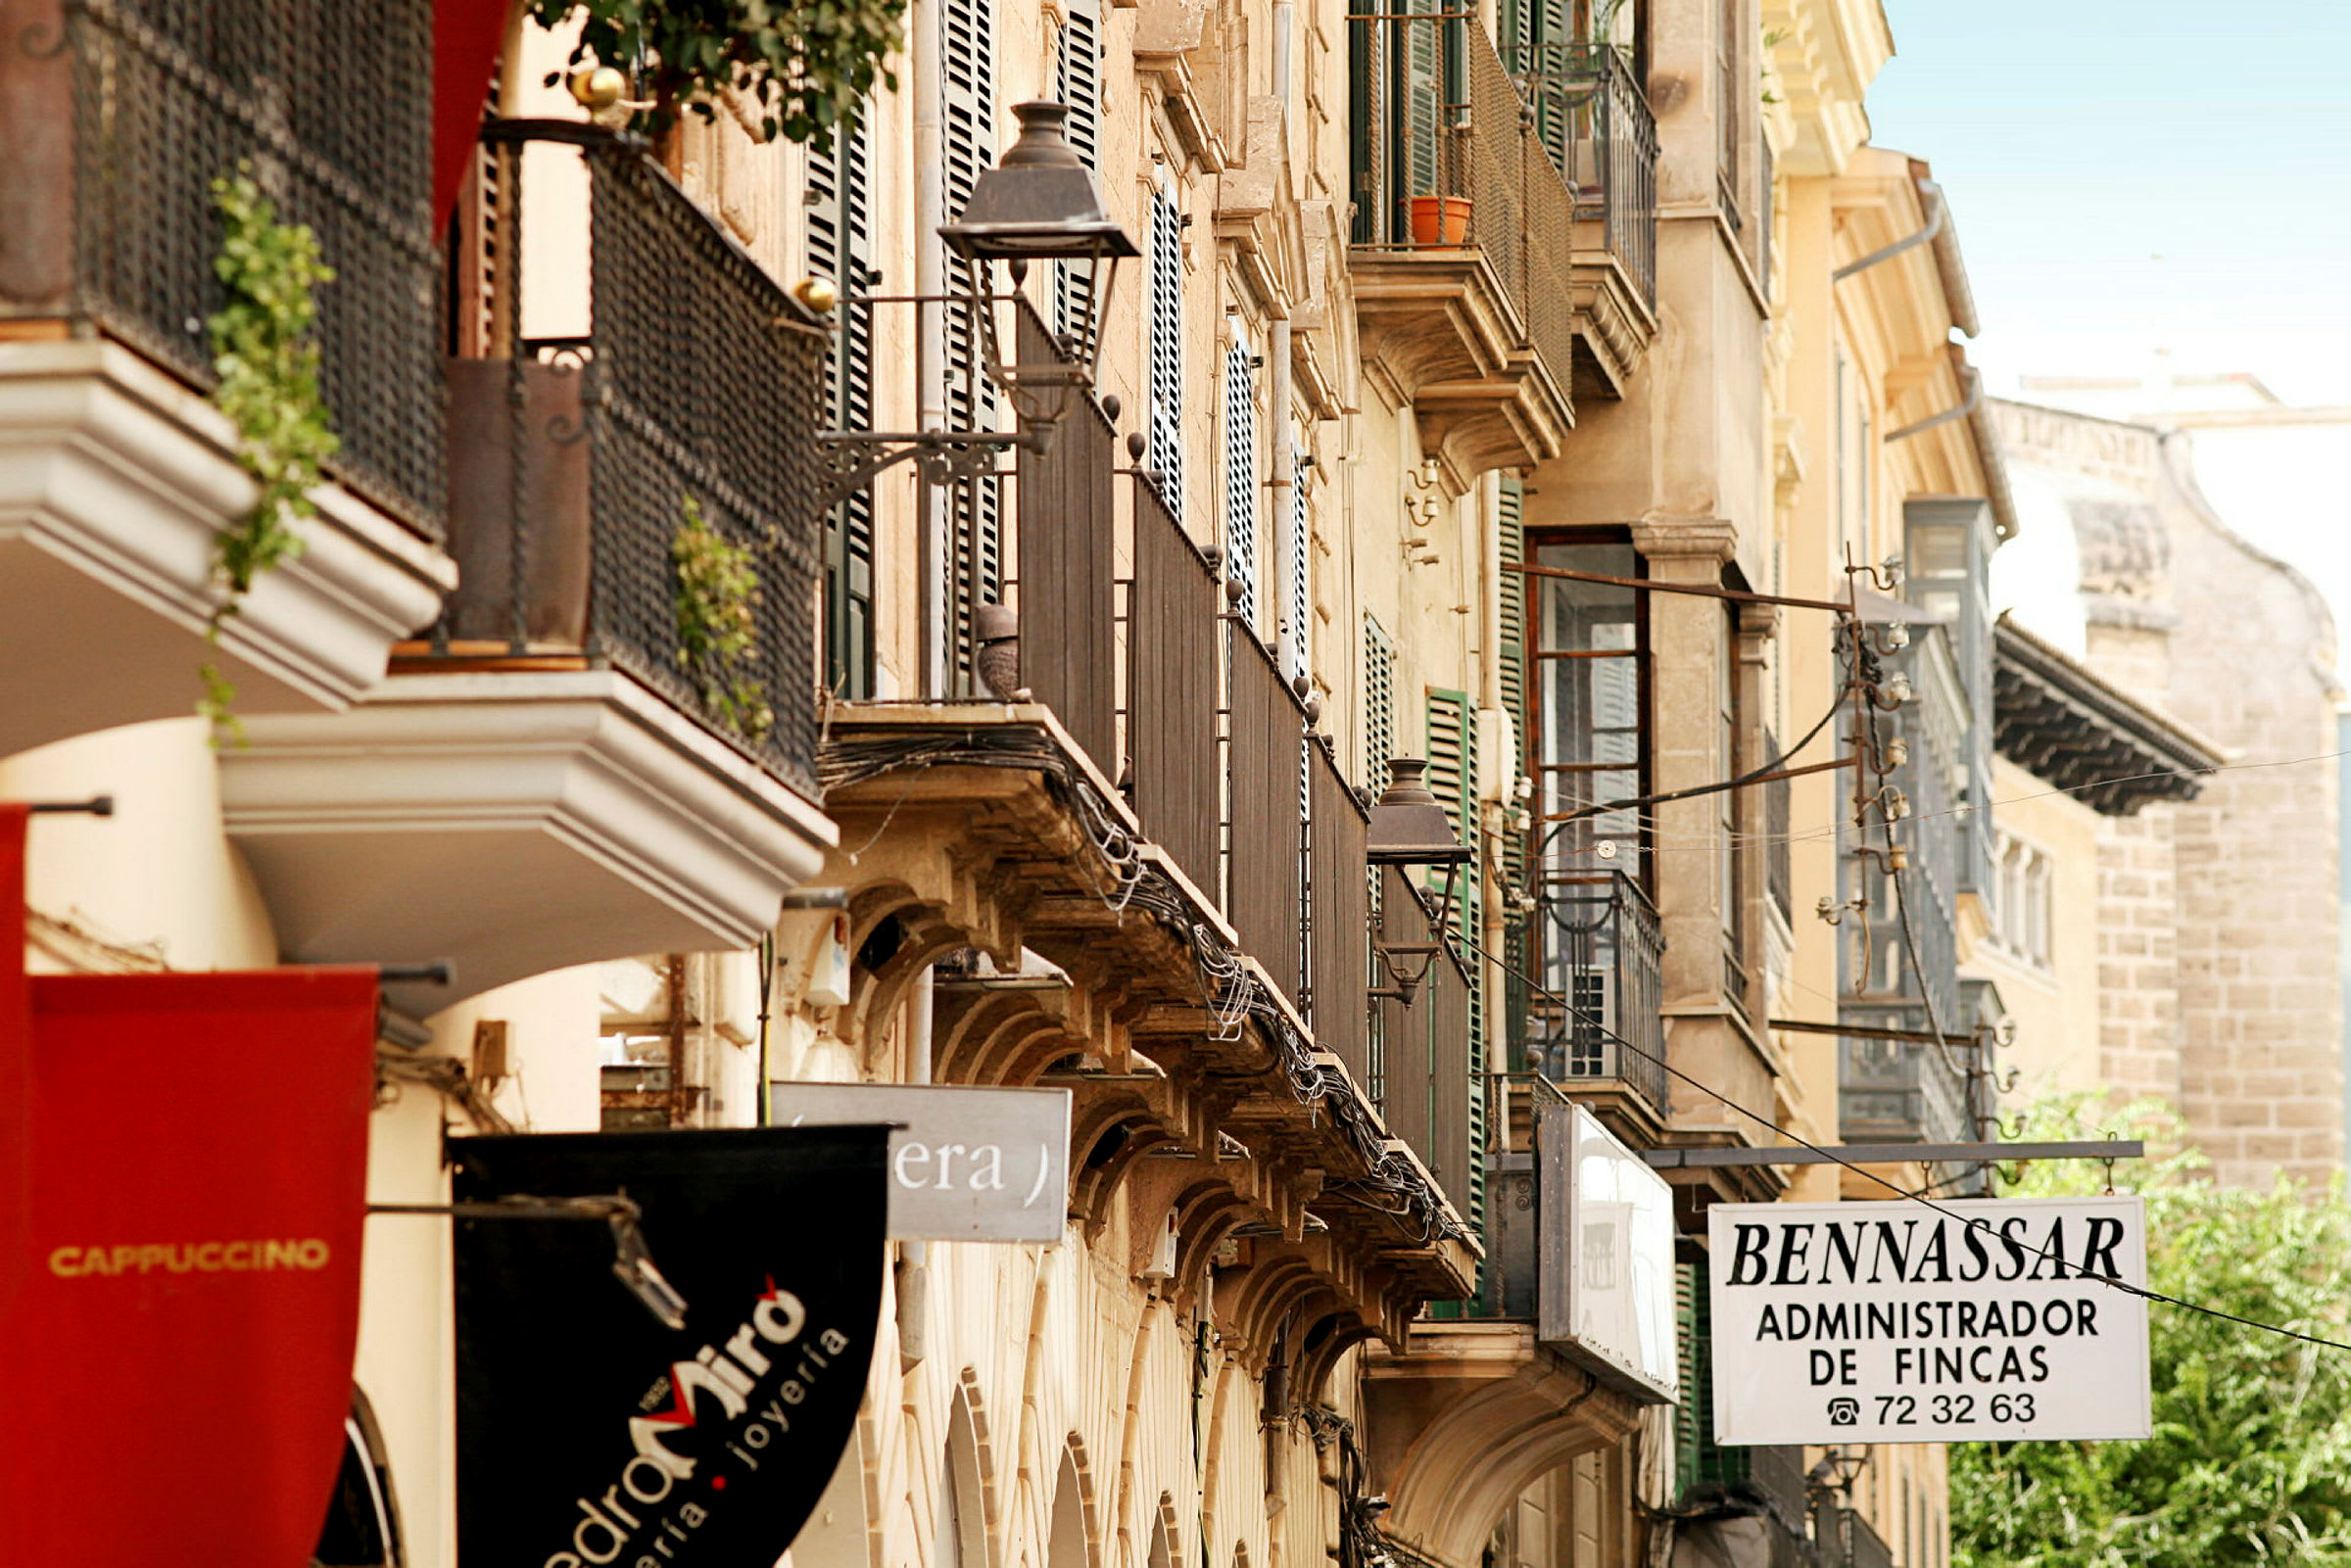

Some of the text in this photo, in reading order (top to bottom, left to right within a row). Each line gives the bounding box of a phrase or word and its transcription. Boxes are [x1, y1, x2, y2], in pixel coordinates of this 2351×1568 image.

[49, 1238, 329, 1277] CAPPUCCINO
[1726, 1216, 2125, 1286] BENNASSAR
[1755, 1299, 2098, 1342] ADMINISTRADOR
[1809, 1345, 2049, 1387] DE FINCAS
[725, 1327, 850, 1471] joyería
[1875, 1393, 2036, 1425] 72 32 63
